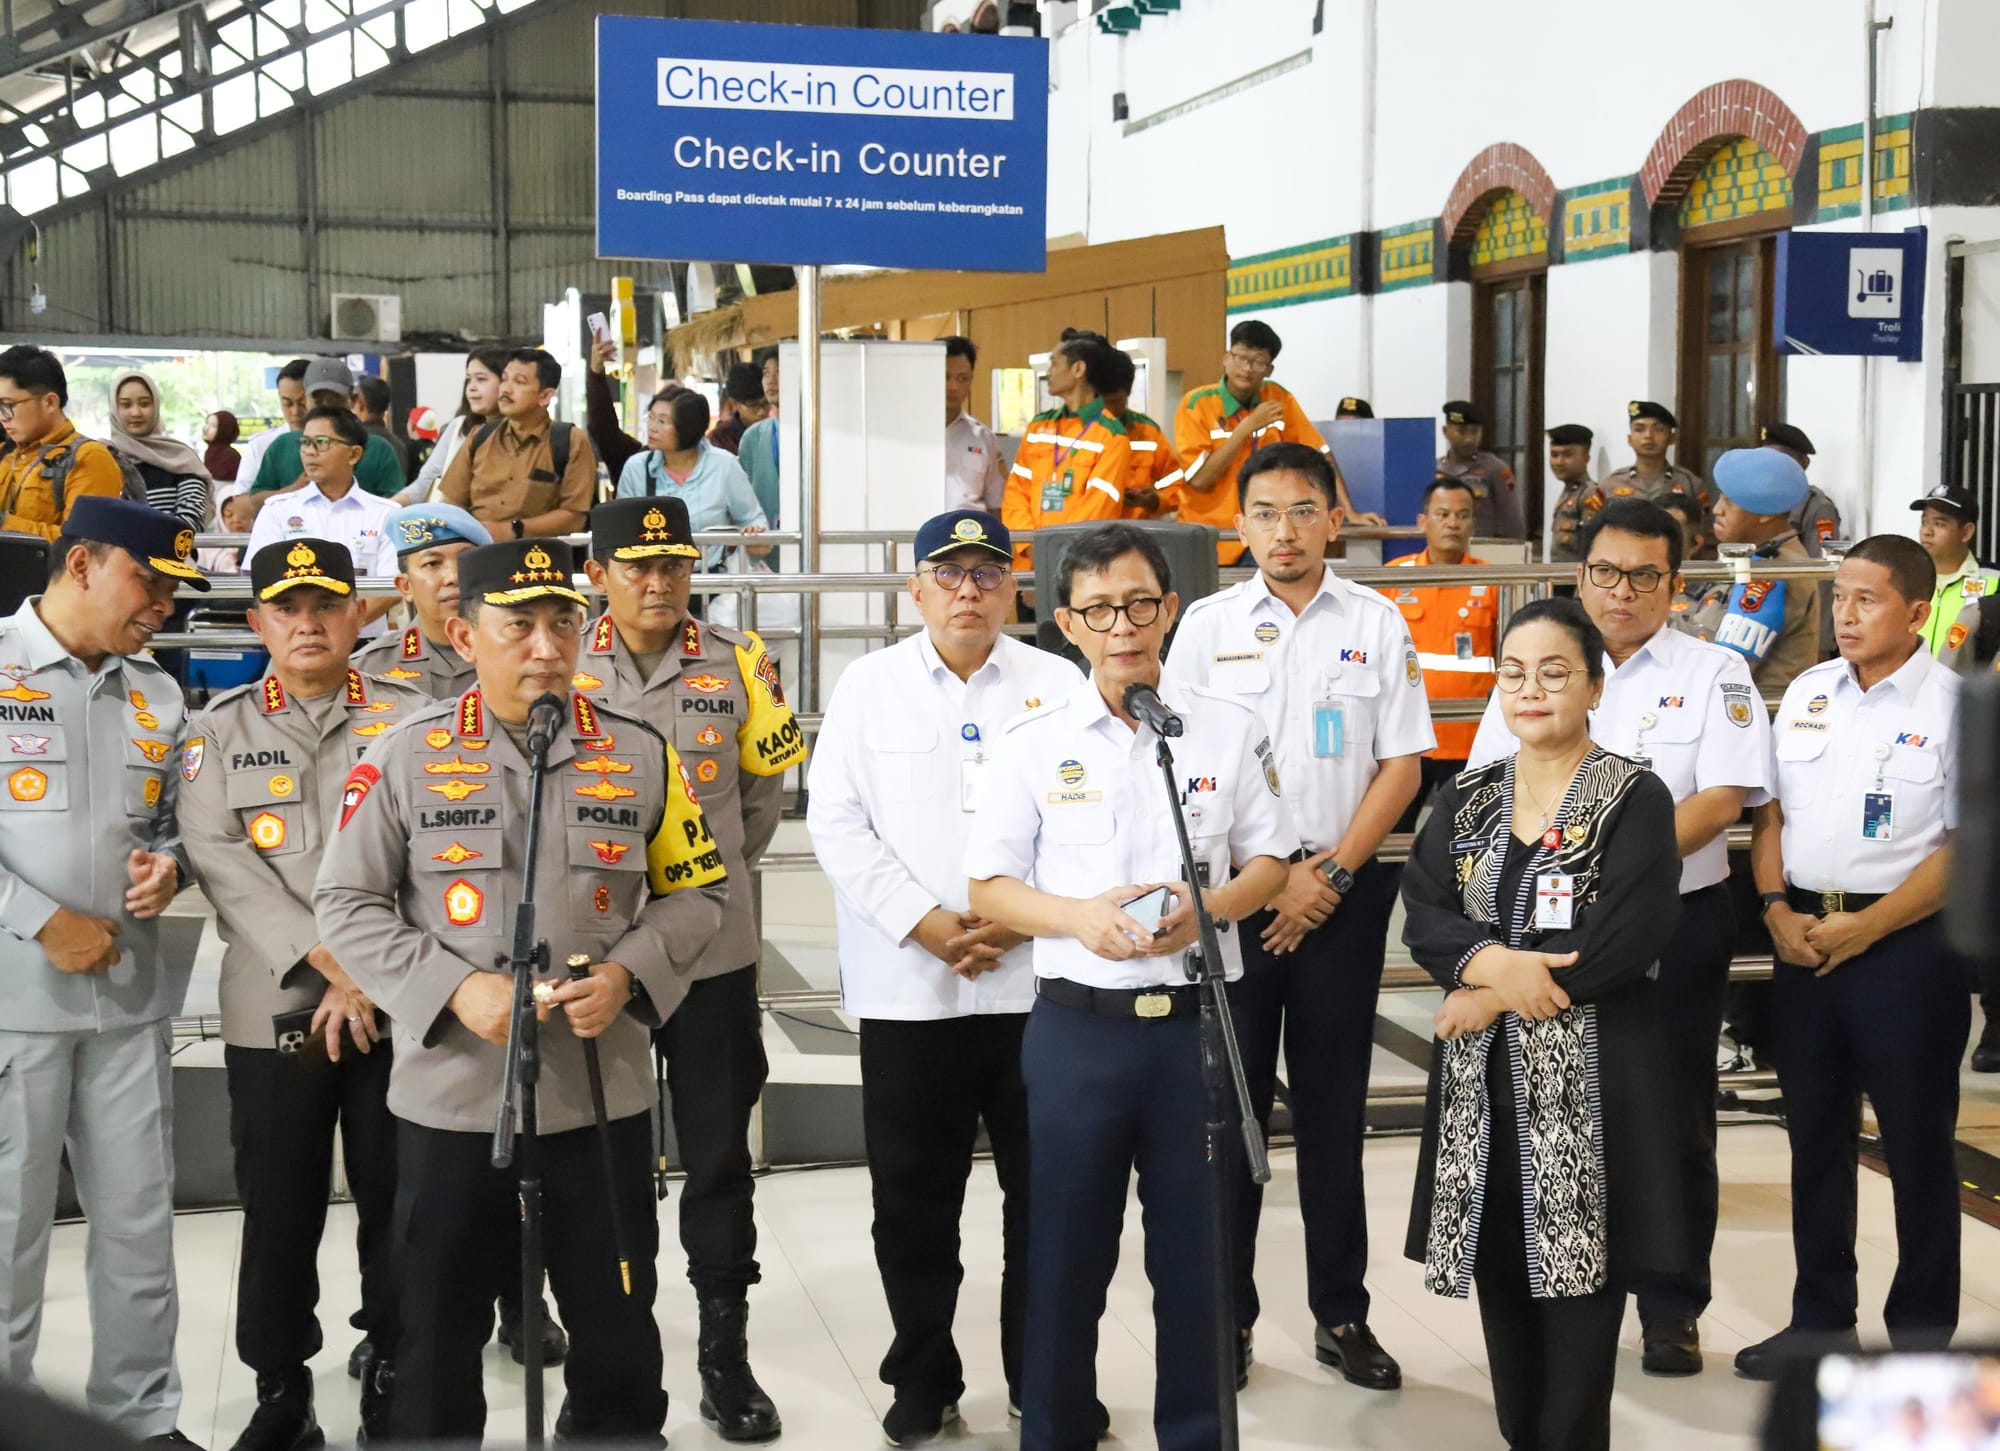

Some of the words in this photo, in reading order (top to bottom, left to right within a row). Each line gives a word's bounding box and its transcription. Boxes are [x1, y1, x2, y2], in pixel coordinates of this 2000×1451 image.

[664, 65, 837, 106] Check-in
[852, 74, 1006, 113] Counter
[674, 136, 841, 173] Check-in
[858, 143, 1006, 179] Counter
[616, 189, 673, 204] Boarding
[675, 191, 705, 203] Pass
[707, 192, 742, 206] dapat
[743, 193, 787, 206] dicetak
[789, 195, 822, 208] mulai
[825, 197, 833, 207] 7
[835, 199, 843, 208] x
[845, 198, 859, 209] 24
[861, 198, 883, 212] jam
[886, 200, 936, 212] sebelum
[938, 201, 1024, 216] keberangkatan
[0, 704, 55, 722] RIVAN
[682, 698, 734, 715] POLRI
[1794, 721, 1826, 730] ROCHADI
[232, 750, 291, 770] FADIL
[768, 744, 800, 767] KETUPAT
[420, 809, 496, 829] L.SIGIT.P
[577, 806, 638, 827] POLRI
[664, 860, 694, 883] OPS
